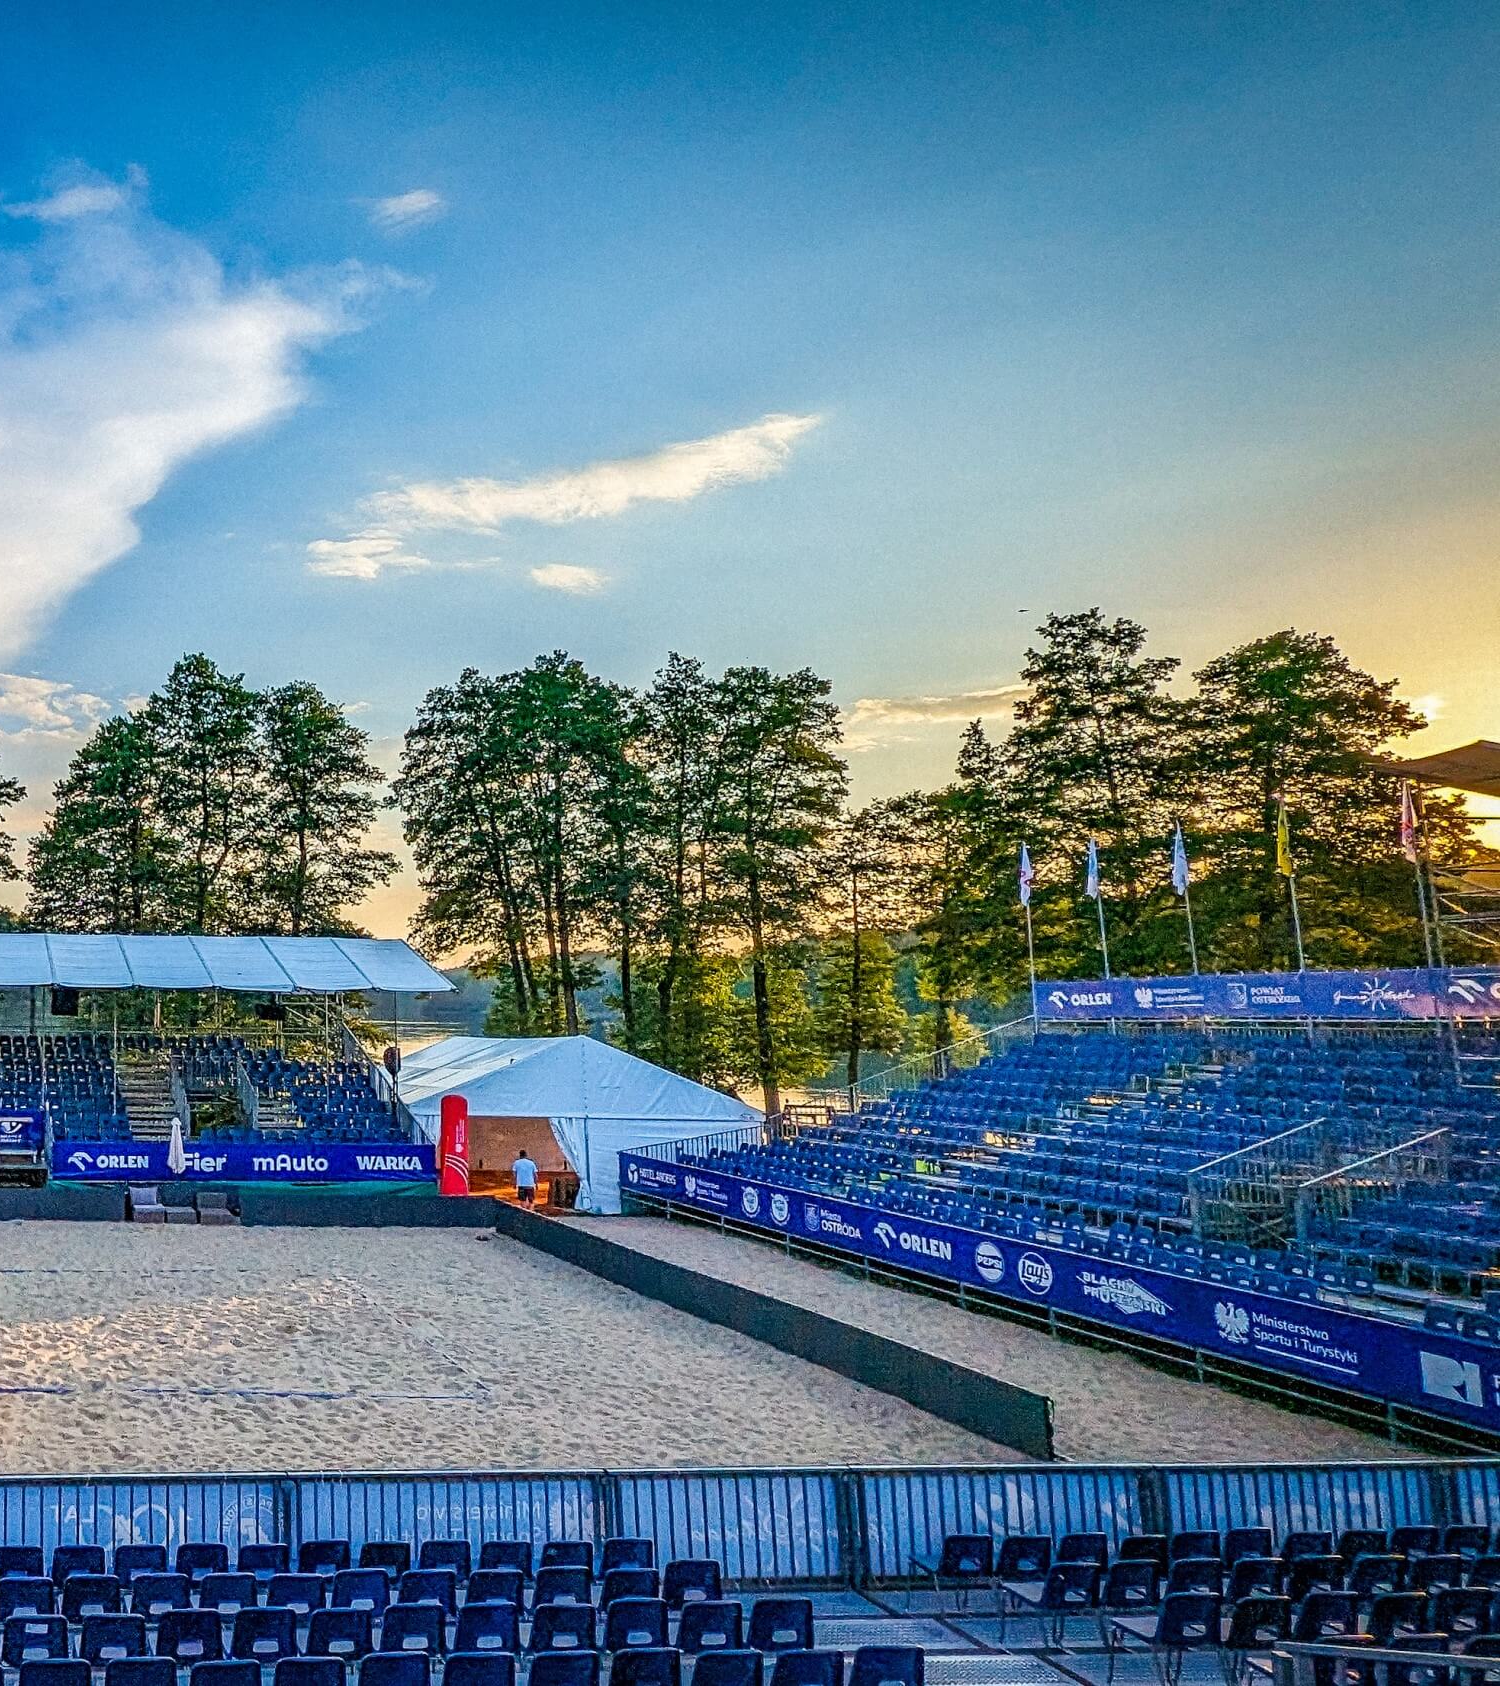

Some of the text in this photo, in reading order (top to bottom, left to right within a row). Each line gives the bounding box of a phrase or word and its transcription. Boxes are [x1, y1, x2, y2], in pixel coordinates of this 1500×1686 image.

[1070, 992, 1112, 1006] ORLEN
[1250, 986, 1285, 996] POWIAT
[96, 1154, 149, 1169] ORLEN
[253, 1154, 329, 1172] mAuto
[356, 1155, 423, 1171] WARKA
[821, 1219, 862, 1240] OSTRÓDA
[900, 1232, 952, 1261] ORLEN
[1252, 1311, 1330, 1341] Ministerstwo
[1253, 1326, 1293, 1349] Sportu
[1302, 1338, 1359, 1364] Turystyki
